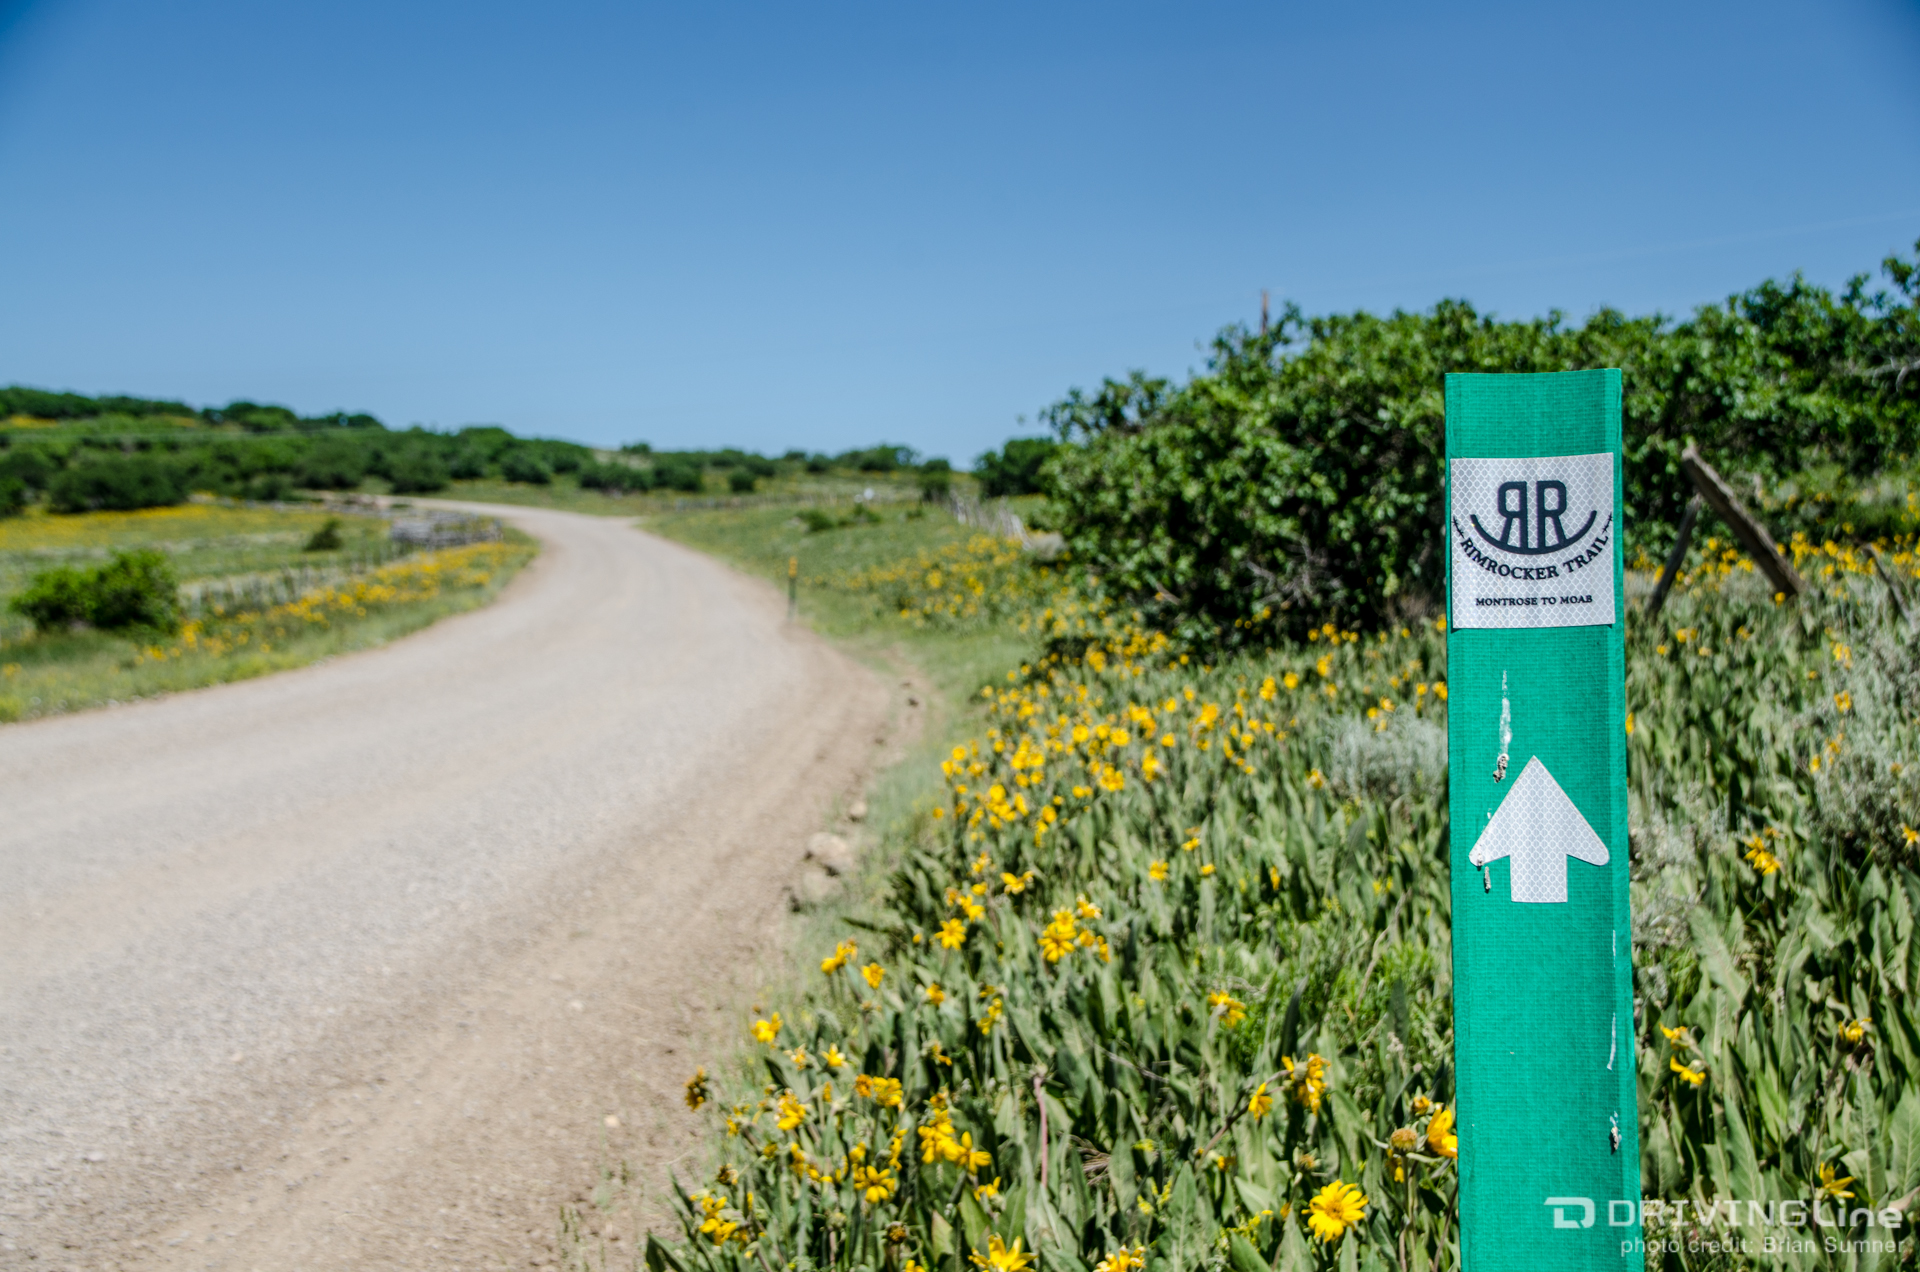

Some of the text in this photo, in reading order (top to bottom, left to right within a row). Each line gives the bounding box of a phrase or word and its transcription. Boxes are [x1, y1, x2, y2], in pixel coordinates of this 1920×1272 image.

[1460, 535, 1608, 580] RIMROCKER TRAIL
[1475, 595, 1593, 606] MONTROSE TO MOAB
